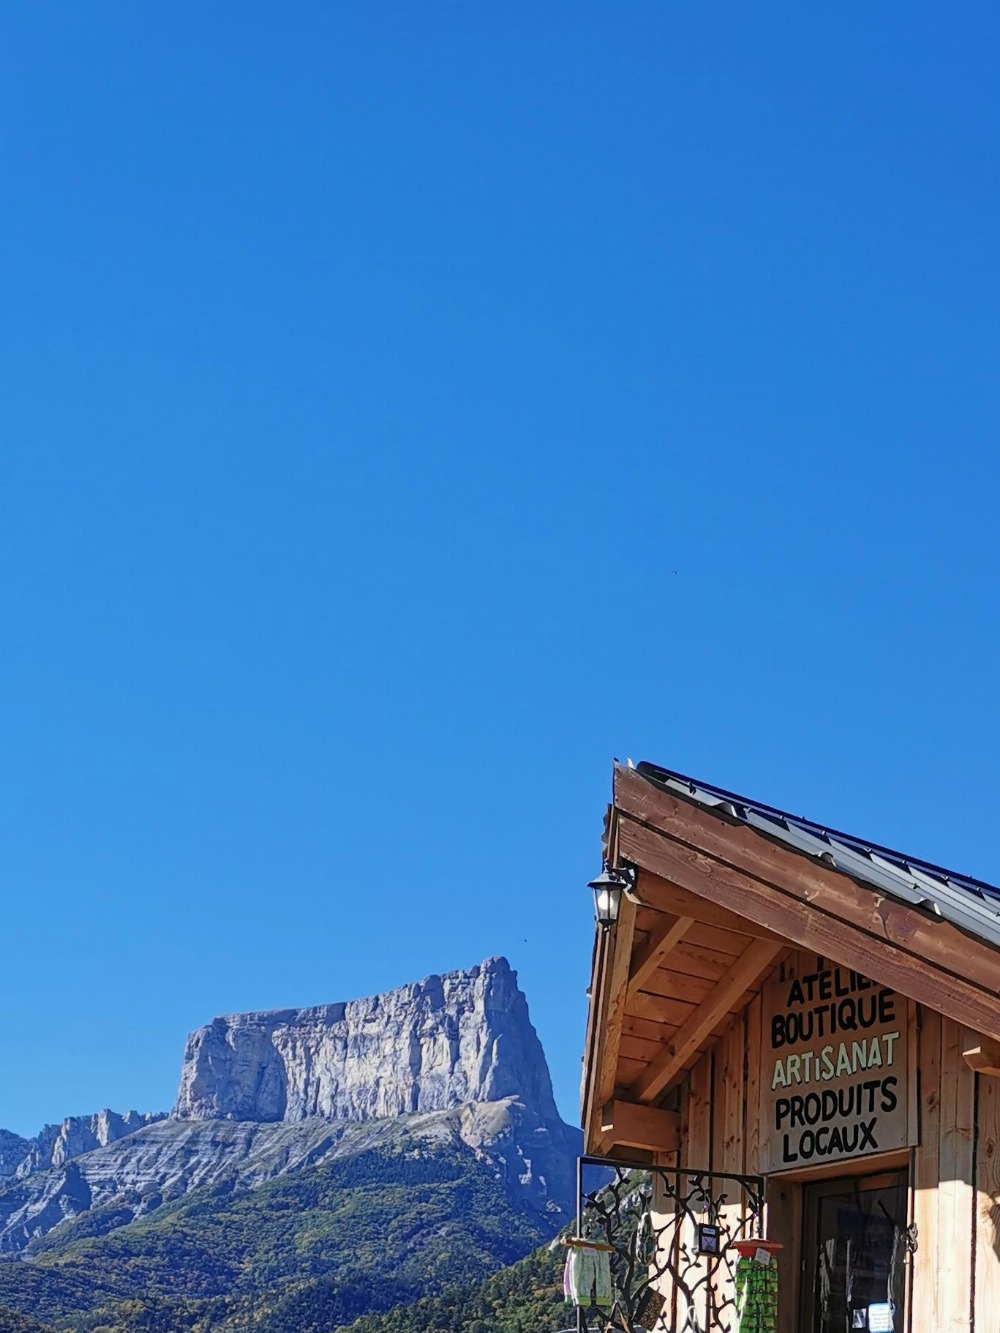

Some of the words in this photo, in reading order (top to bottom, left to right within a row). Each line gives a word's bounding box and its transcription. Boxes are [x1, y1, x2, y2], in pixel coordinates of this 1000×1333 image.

[786, 967, 879, 1008] ATELIE
[770, 988, 896, 1049] BOUTIQUE
[771, 1031, 900, 1091] ARTISANAT
[775, 1076, 898, 1131] PRODUITS
[782, 1116, 879, 1163] LOCAUX
